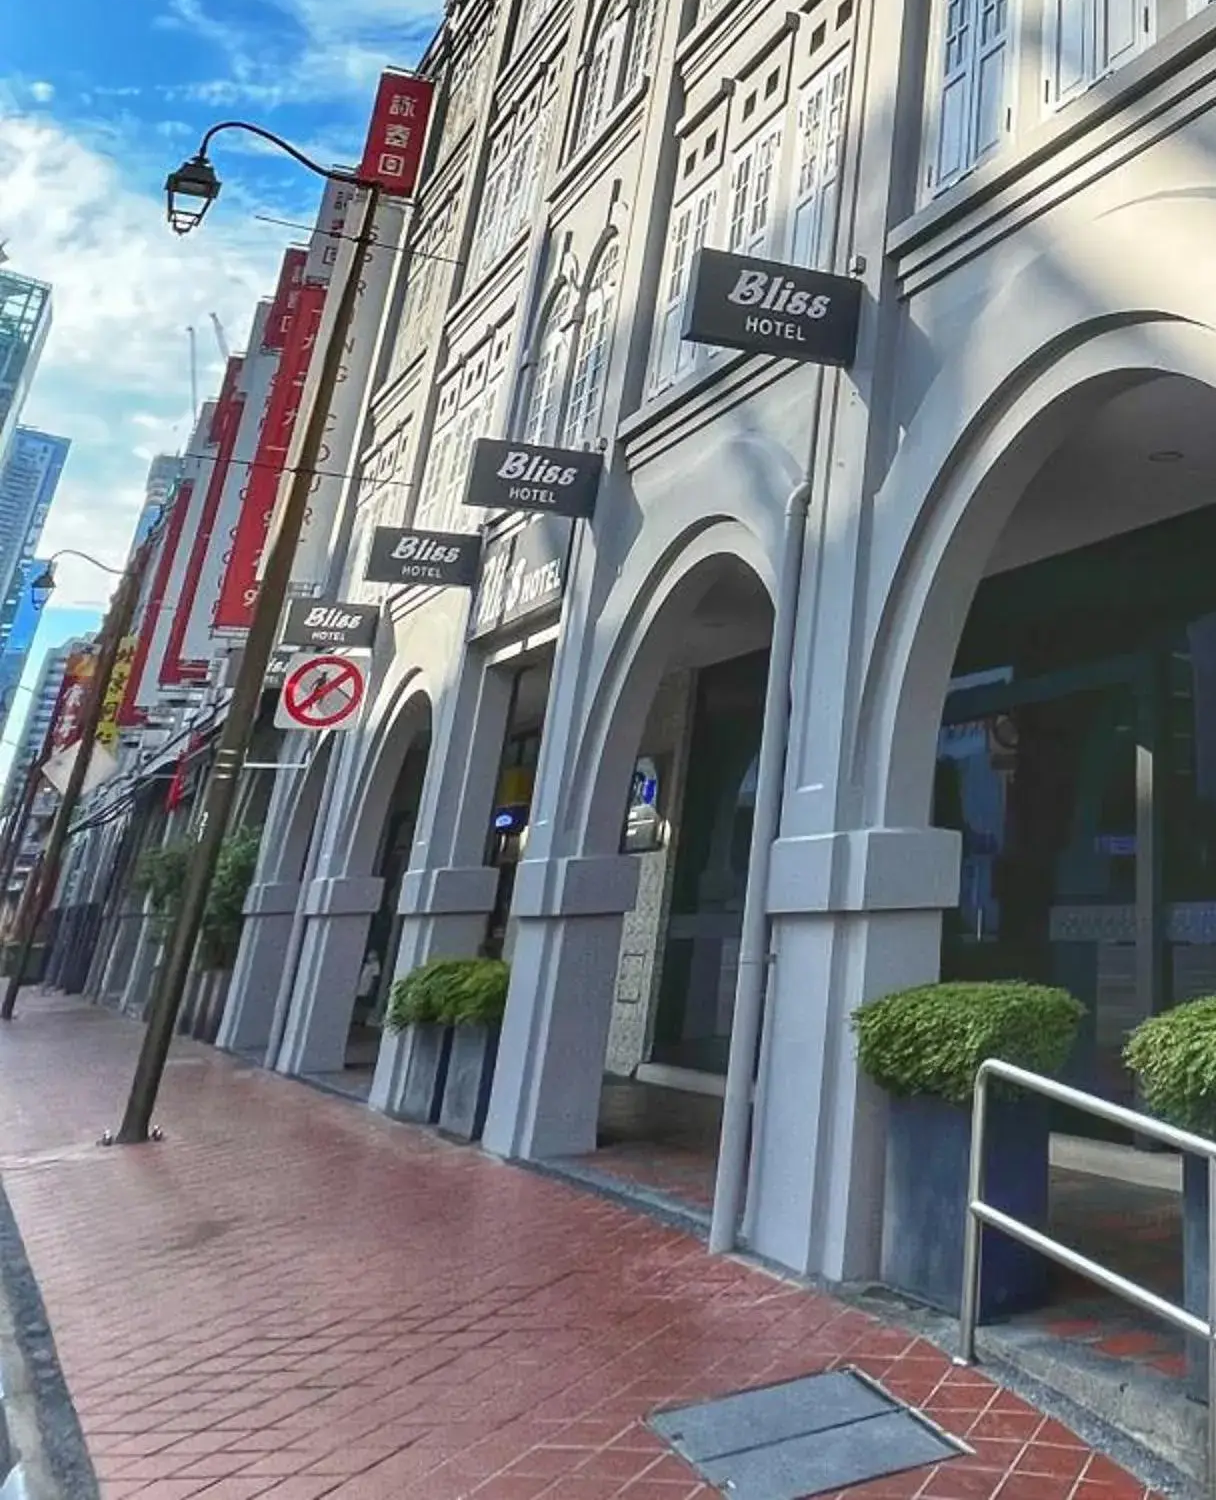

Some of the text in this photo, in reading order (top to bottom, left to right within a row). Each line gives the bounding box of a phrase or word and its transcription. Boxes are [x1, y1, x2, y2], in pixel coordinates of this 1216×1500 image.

[727, 269, 832, 320] Bliss
[744, 315, 807, 343] HOTEL
[496, 450, 580, 487] Bliss
[508, 486, 557, 505] HOTEL
[389, 536, 462, 565] Bliss
[401, 565, 443, 580] HOTEL
[303, 607, 363, 629] Bliss
[311, 630, 345, 642] HOTEL
